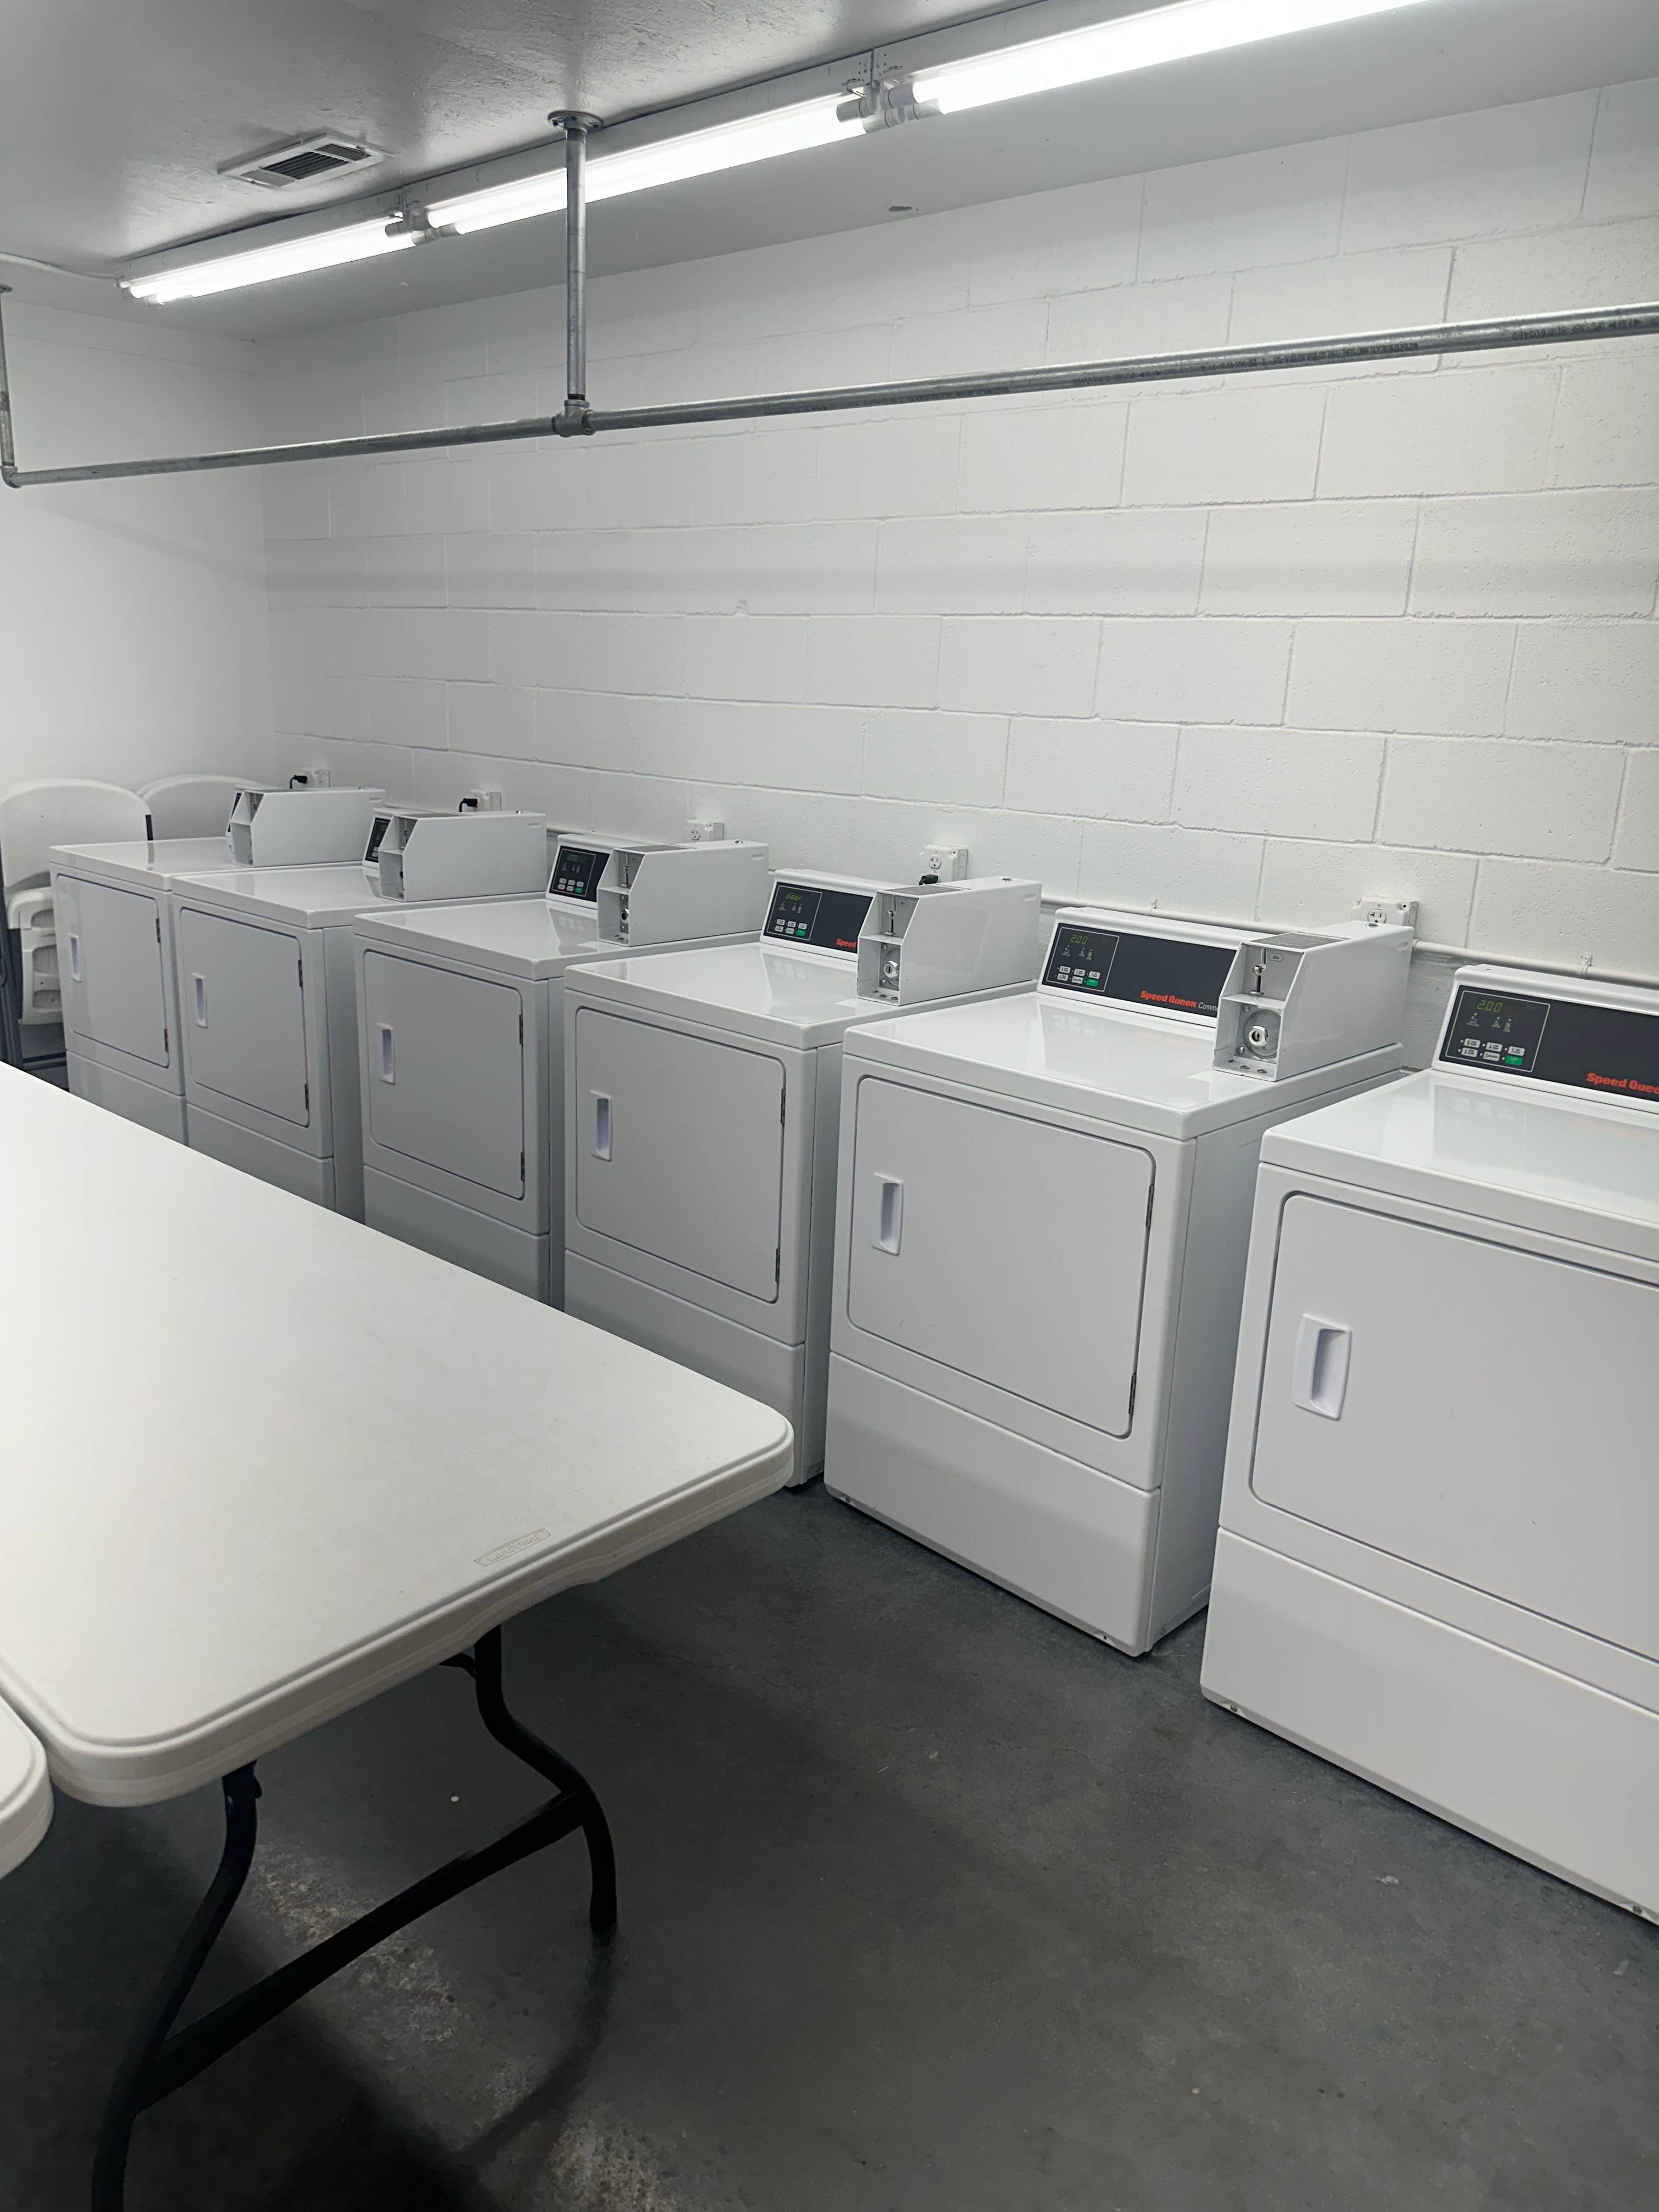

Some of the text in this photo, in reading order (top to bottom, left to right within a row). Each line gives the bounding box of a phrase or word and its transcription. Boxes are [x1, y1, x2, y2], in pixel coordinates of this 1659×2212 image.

[836, 938, 857, 948] Speed
[1141, 991, 1169, 1002] Speed
[1169, 995, 1197, 1008] Queen
[1585, 1071, 1628, 1088] Speed
